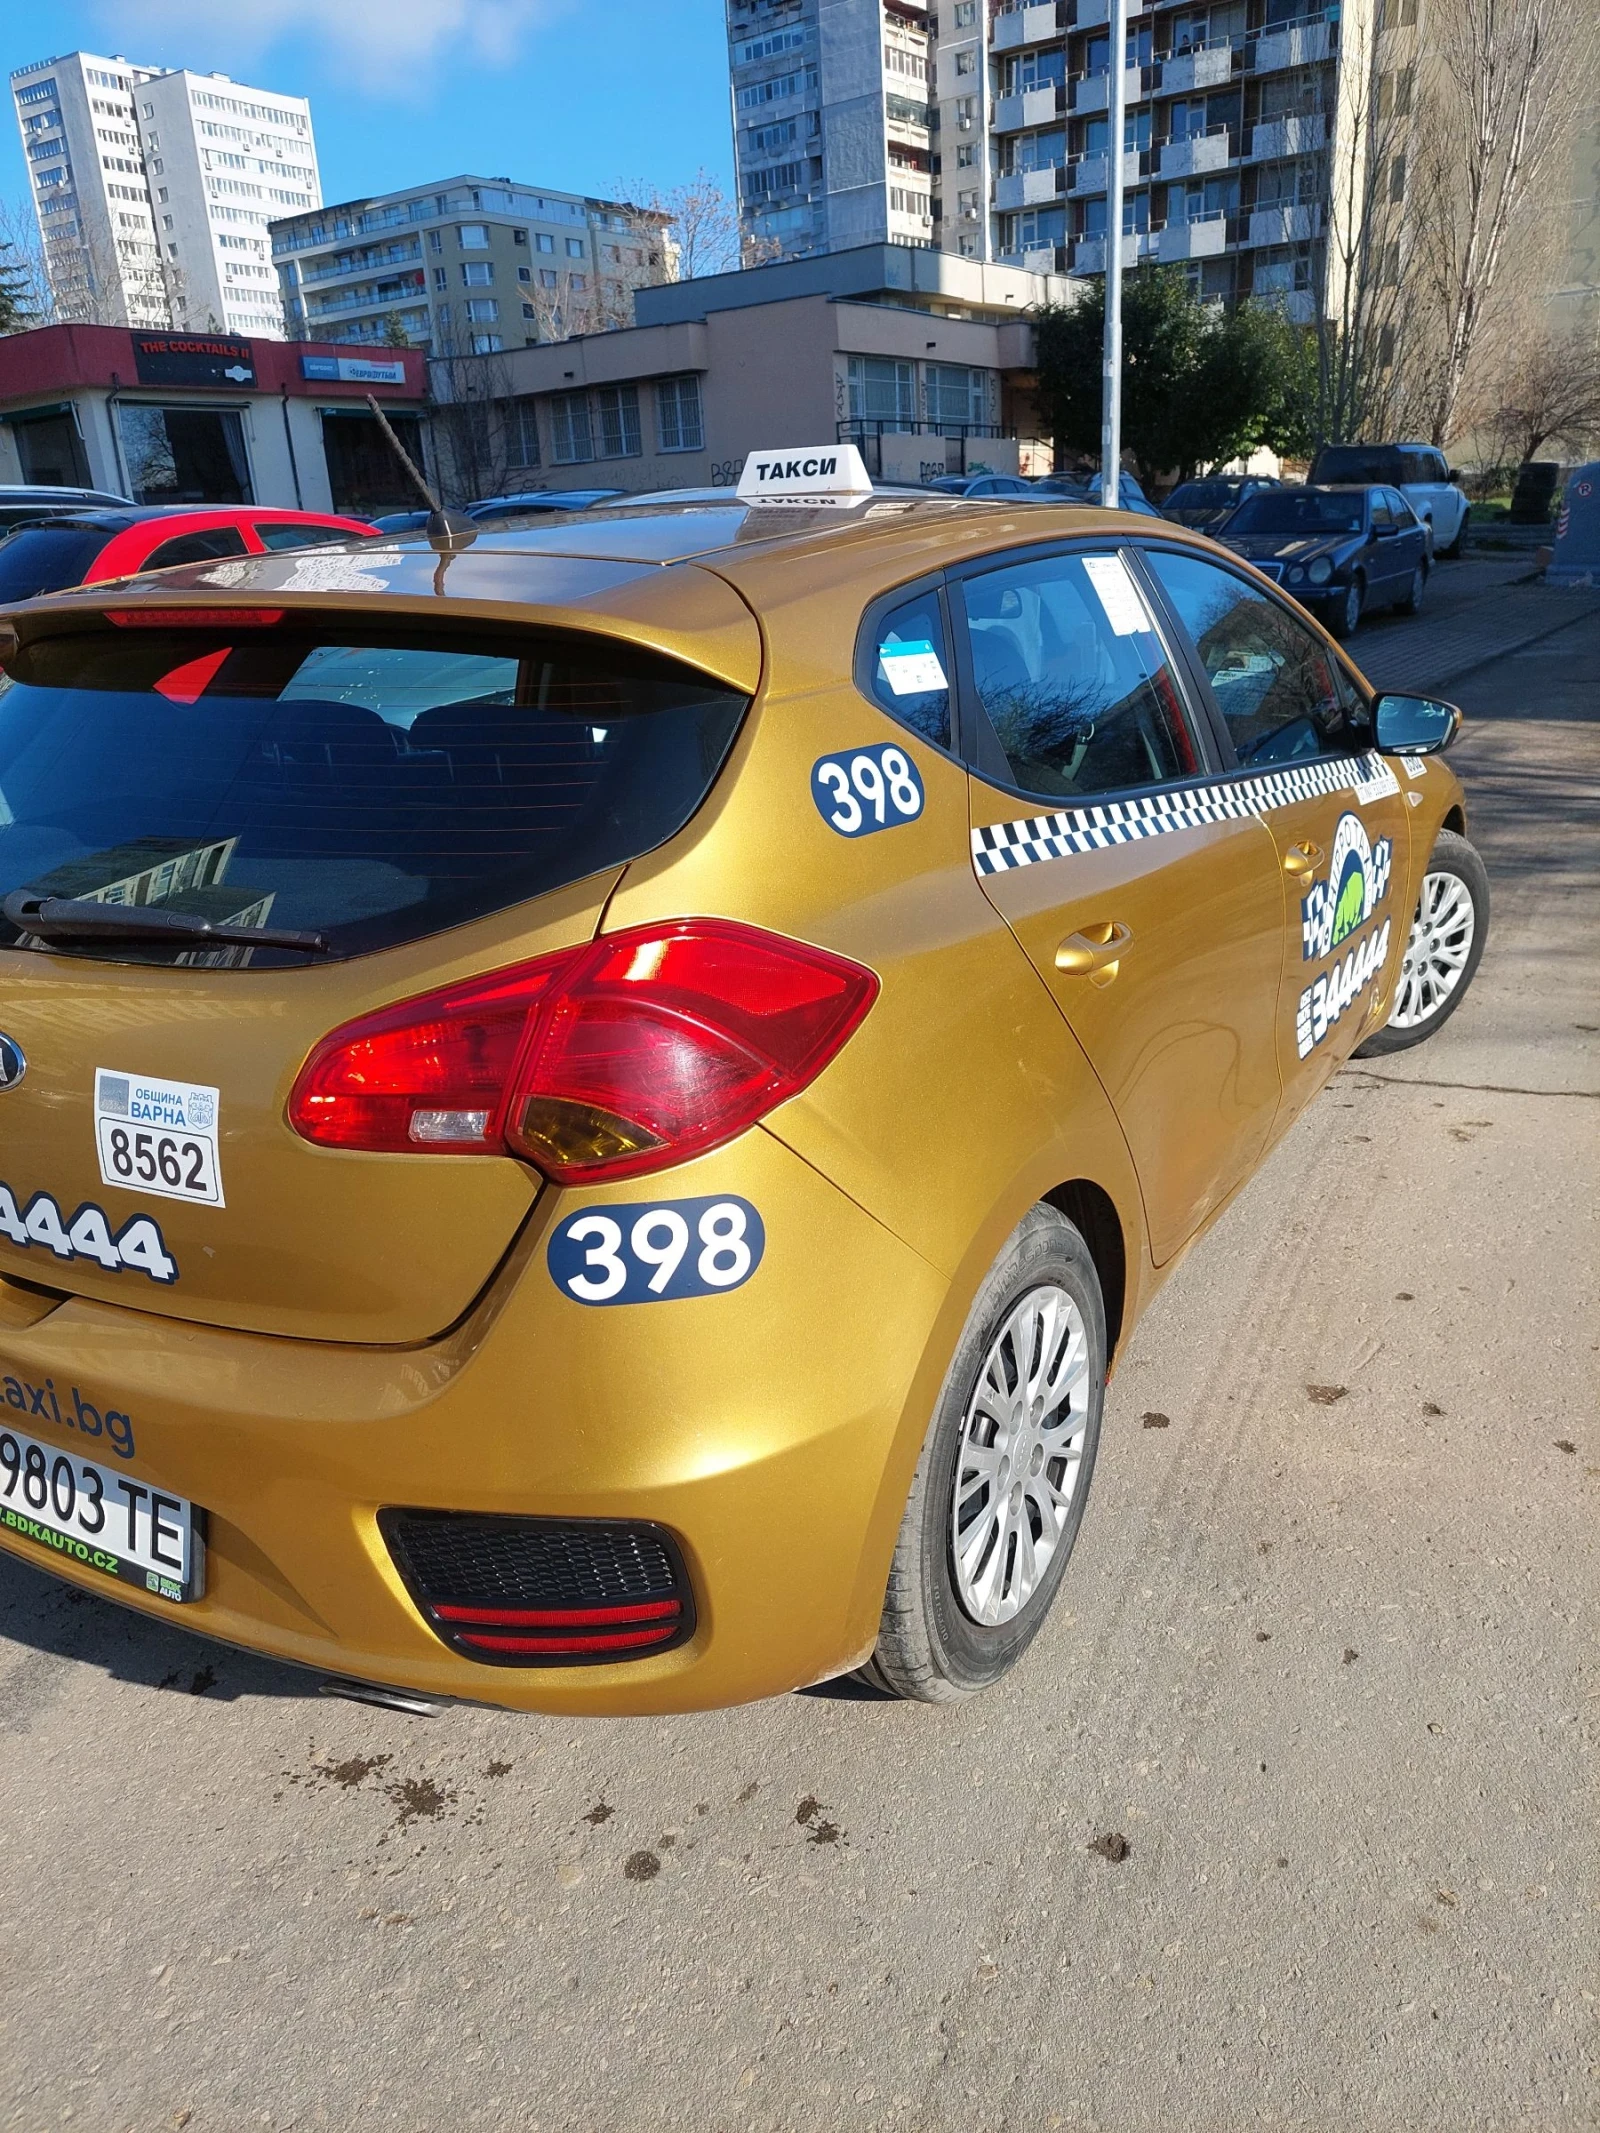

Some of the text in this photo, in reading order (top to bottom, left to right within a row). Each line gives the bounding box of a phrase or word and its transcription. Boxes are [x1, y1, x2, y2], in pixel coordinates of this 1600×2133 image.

[141, 341, 167, 353] THE
[169, 340, 238, 357] COCKTAILS
[756, 457, 837, 481] ТАКСИ
[818, 748, 921, 833] 398
[131, 1101, 187, 1127] ВАРНА
[135, 1088, 183, 1107] ОБЩИНА
[110, 1128, 208, 1192] 8562
[566, 1202, 752, 1301] 398
[0, 1376, 136, 1460] axi.bg
[0, 1506, 119, 1574] .BDKAUTO.CZ
[159, 1586, 182, 1602] AUTO
